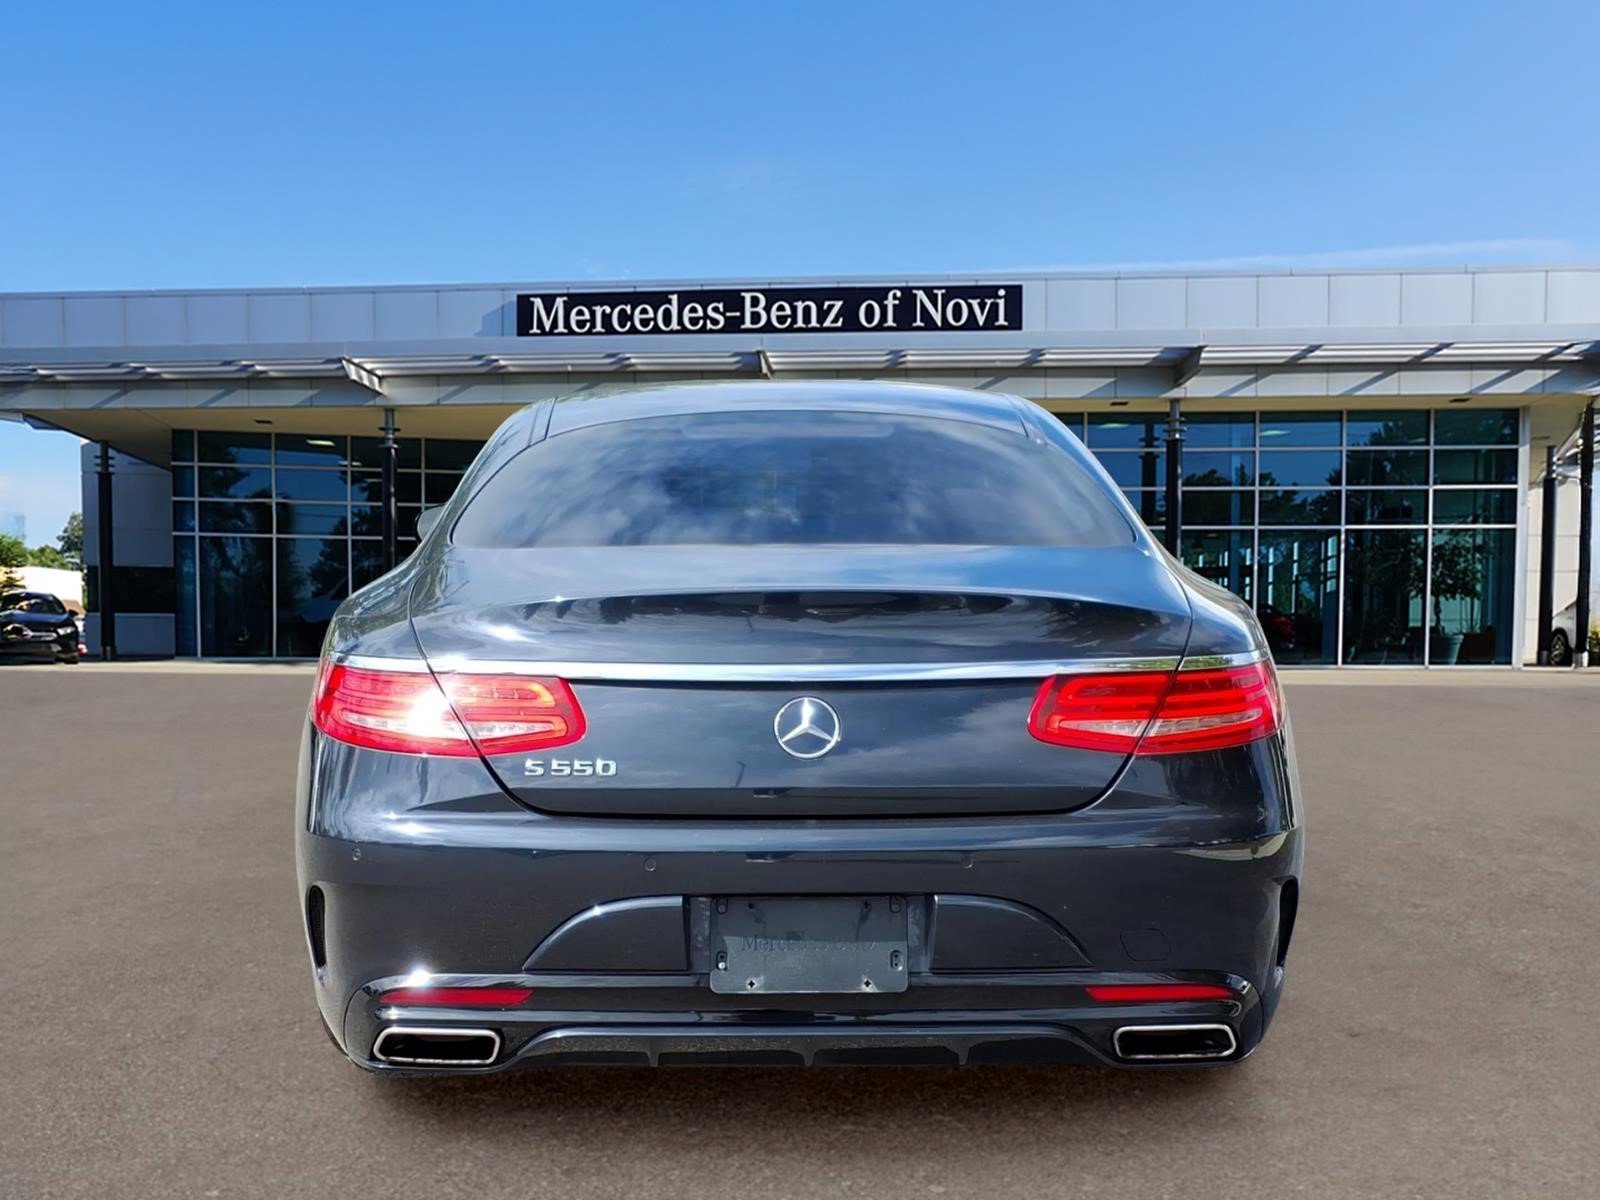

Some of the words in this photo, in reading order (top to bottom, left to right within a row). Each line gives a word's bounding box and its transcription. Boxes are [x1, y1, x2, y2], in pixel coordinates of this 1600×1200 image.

[529, 291, 842, 334] Mercedes-Benz
[858, 289, 901, 328] of
[912, 288, 1009, 327] Novi
[524, 758, 545, 777] S
[550, 758, 617, 777] 550
